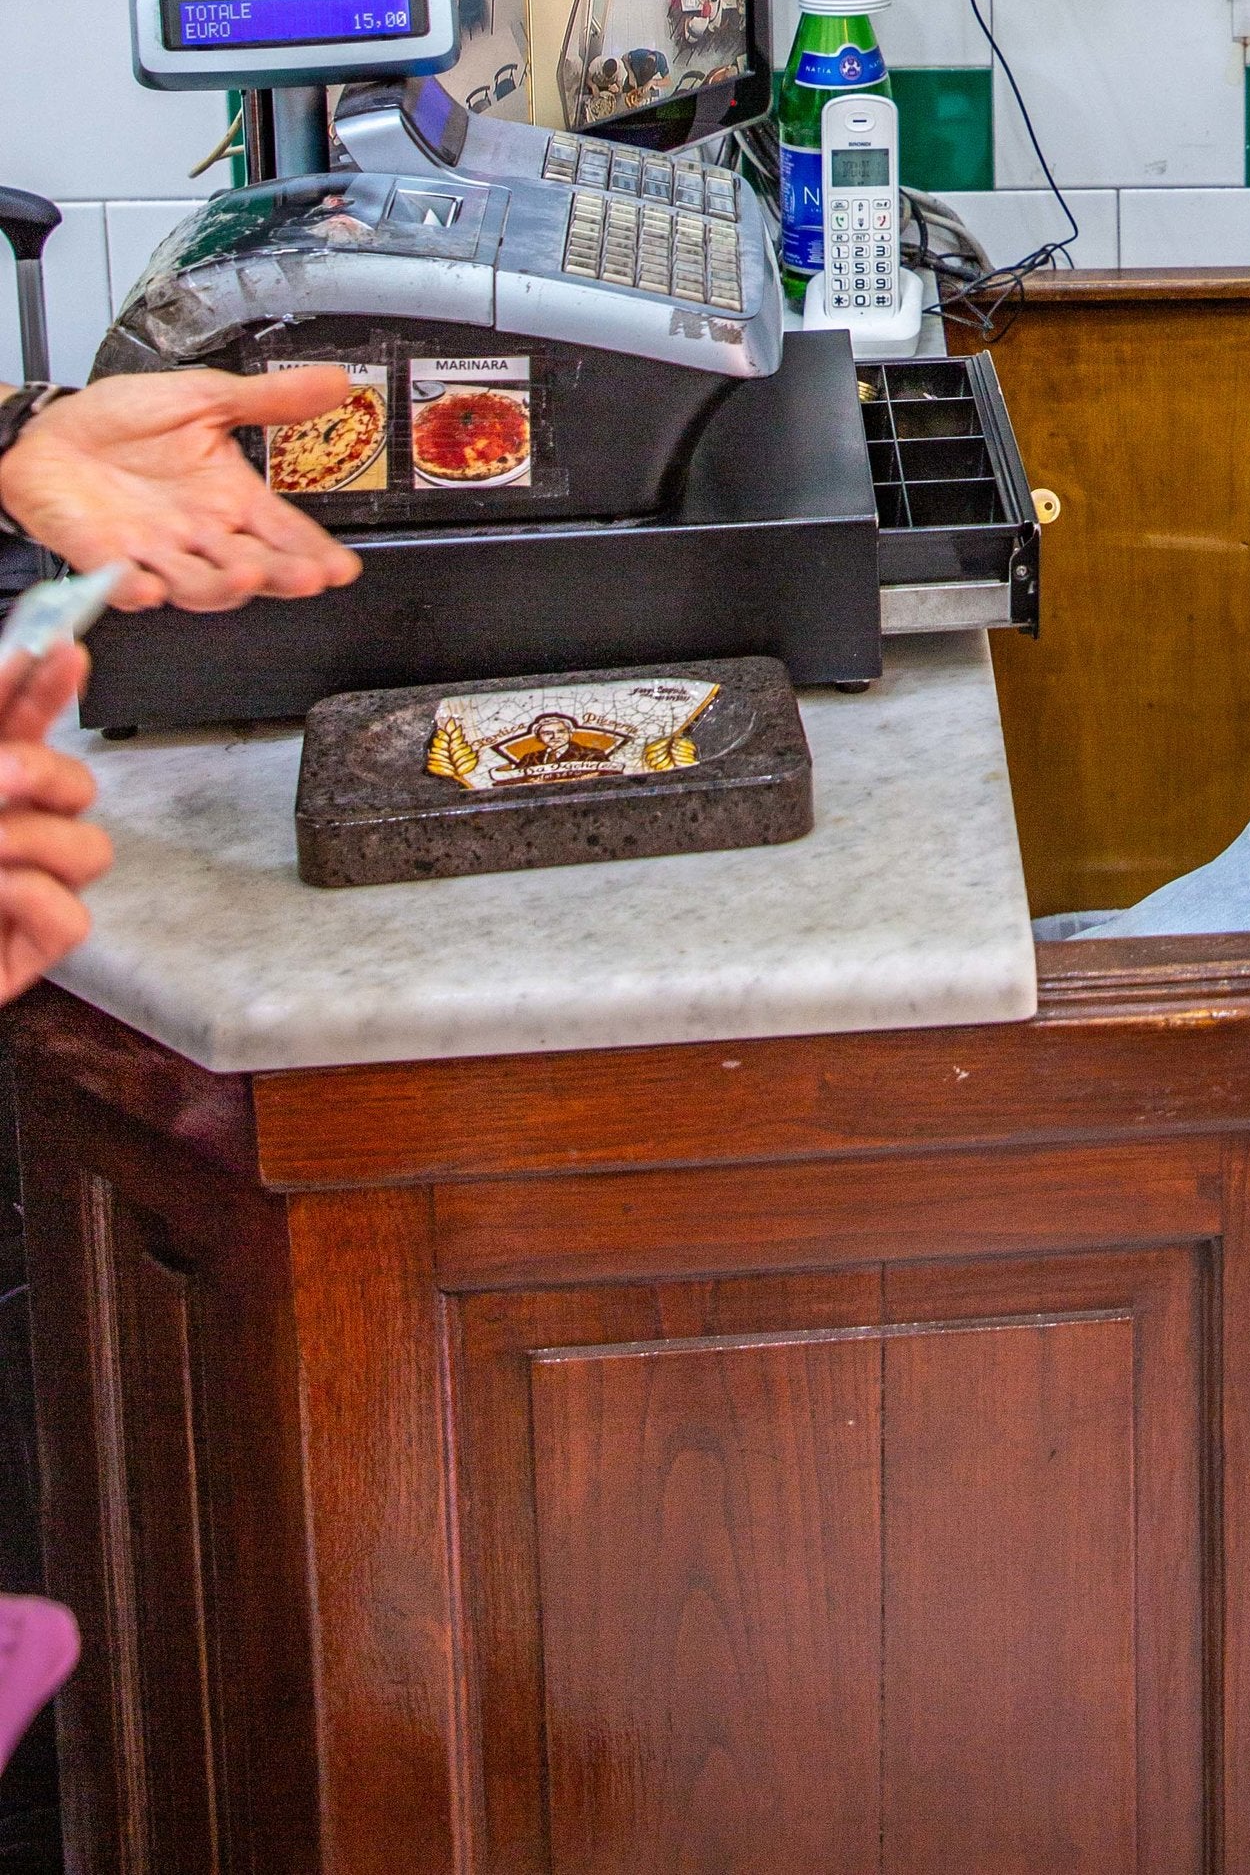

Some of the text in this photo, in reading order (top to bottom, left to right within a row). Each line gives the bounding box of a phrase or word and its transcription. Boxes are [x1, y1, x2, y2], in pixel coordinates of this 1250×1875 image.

[184, 3, 252, 21] TOTALE
[186, 11, 407, 40] EURO 15,00
[805, 65, 832, 74] NATIA
[837, 246, 886, 258] 1 2 3
[834, 262, 886, 274] 4 5 6
[834, 278, 886, 290] 7 8 9
[435, 359, 509, 371] MARINARA
